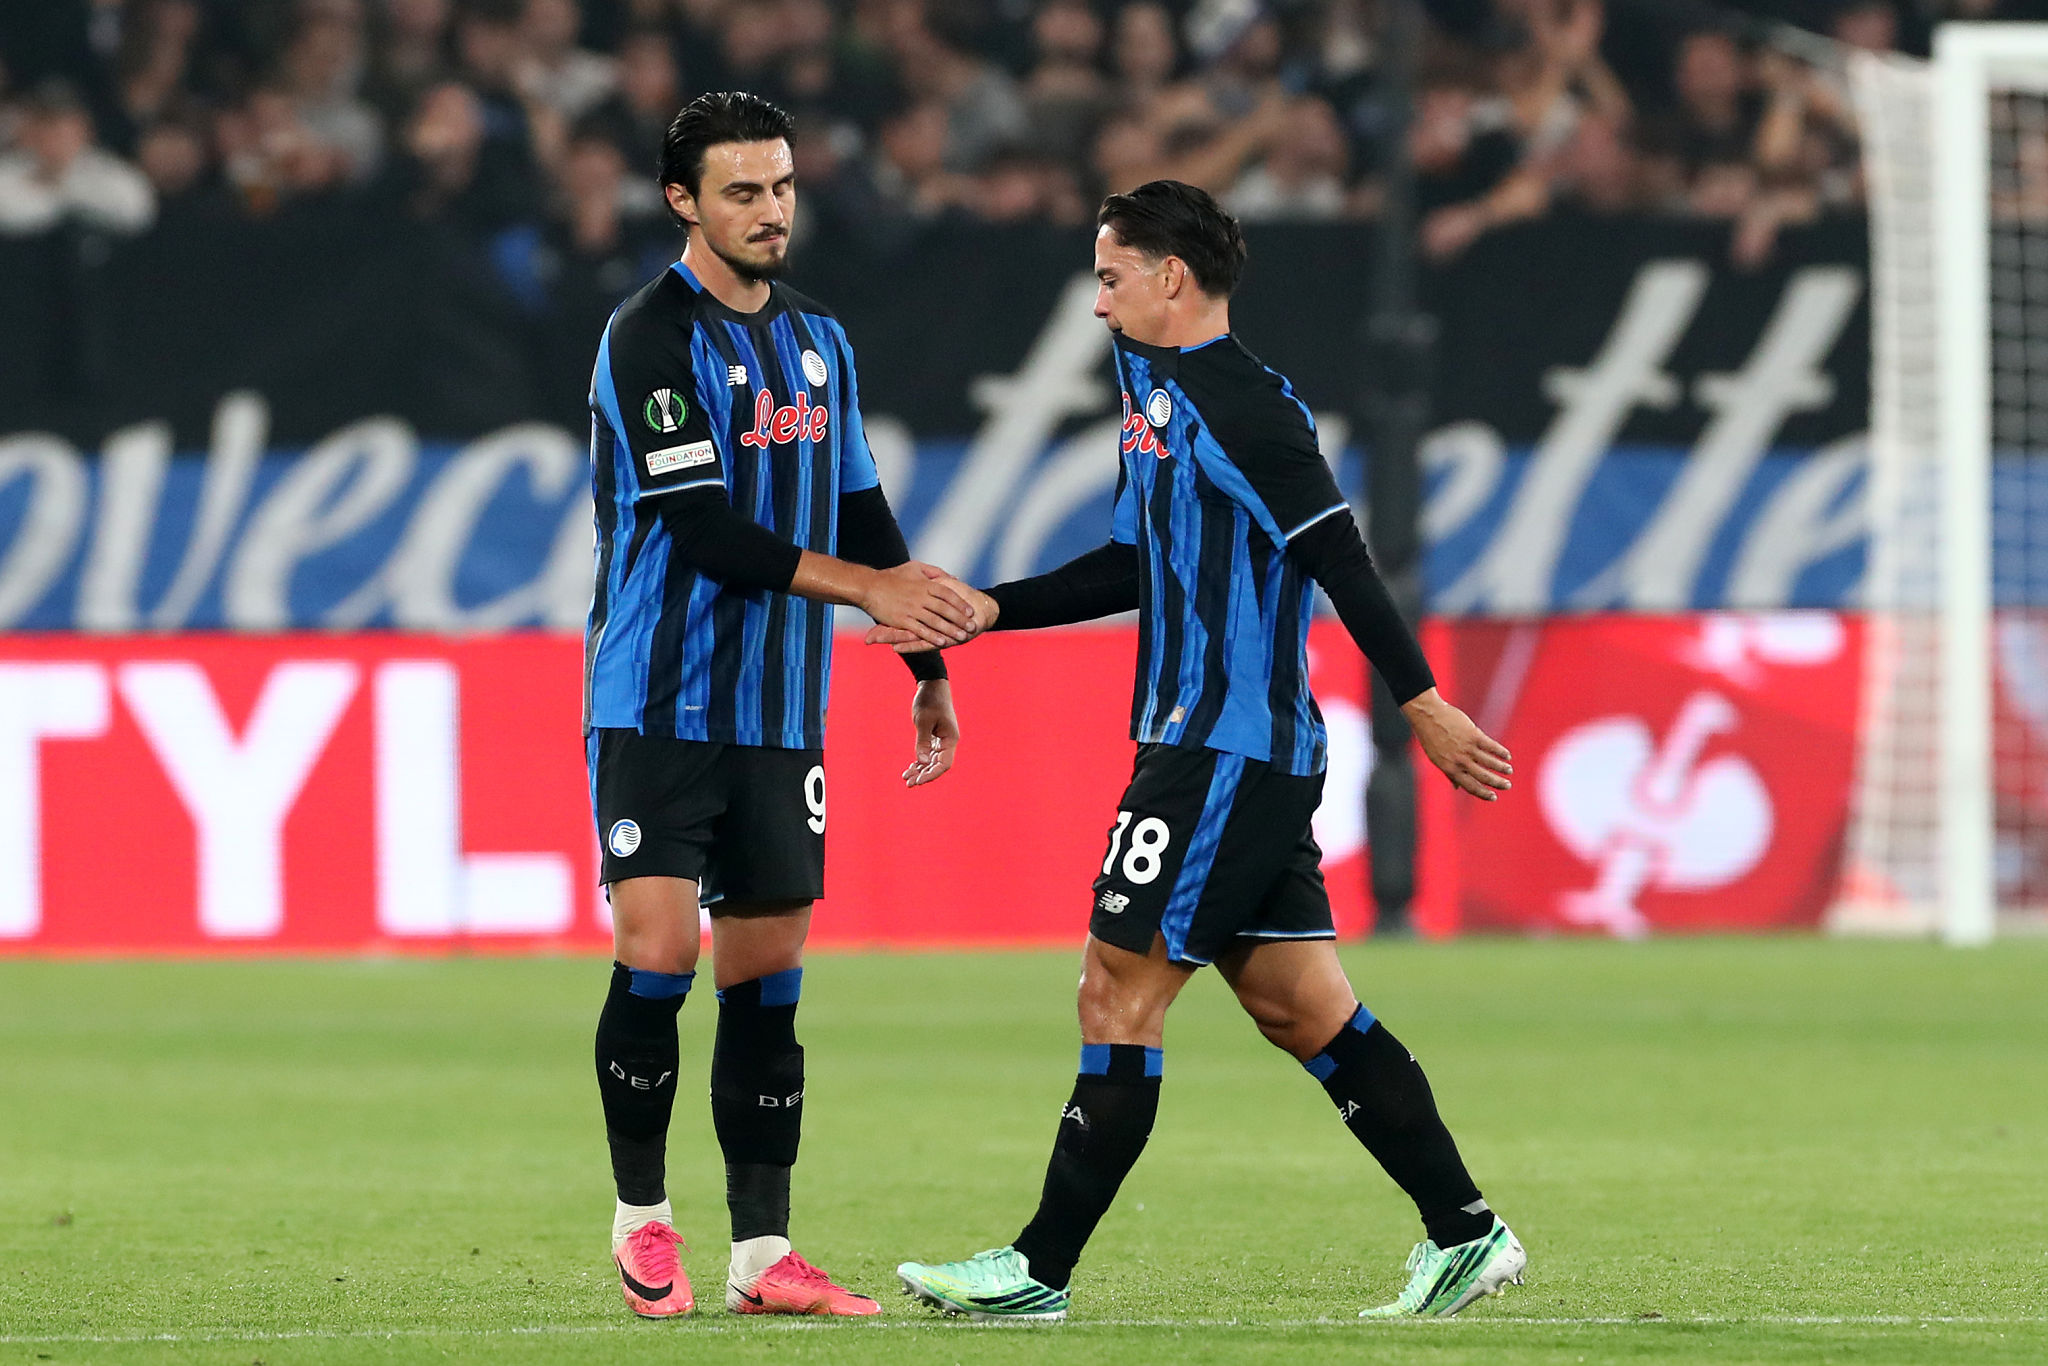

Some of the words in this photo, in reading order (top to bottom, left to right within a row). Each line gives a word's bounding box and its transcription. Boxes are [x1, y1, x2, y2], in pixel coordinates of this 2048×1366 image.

[740, 388, 828, 449] Lete
[649, 447, 712, 467] FOUNDATION
[0, 658, 600, 938] TYL
[804, 764, 826, 834] 9
[1102, 810, 1170, 885] 18
[758, 1091, 805, 1108] DE
